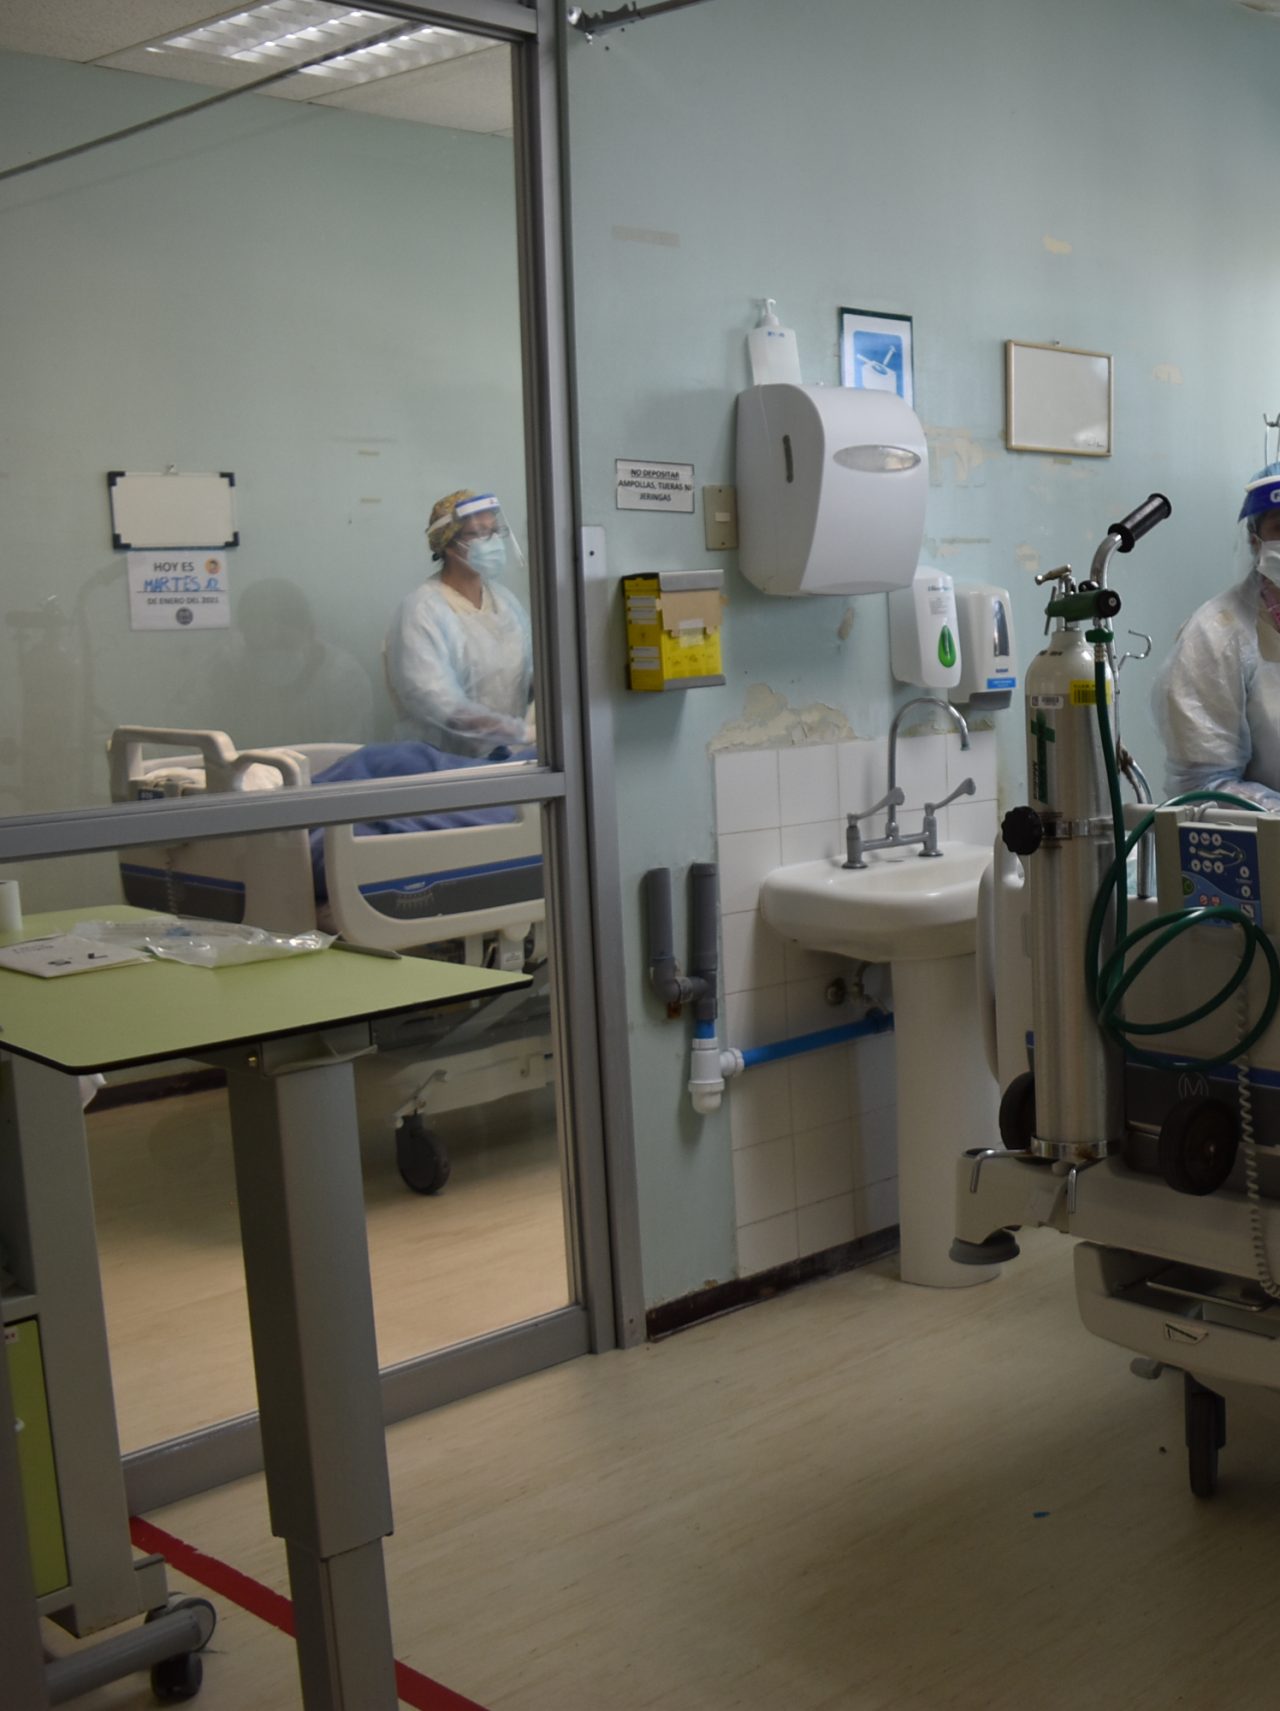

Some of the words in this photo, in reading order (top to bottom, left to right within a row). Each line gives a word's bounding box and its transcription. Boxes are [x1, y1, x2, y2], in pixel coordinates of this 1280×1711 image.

[631, 469, 641, 478] NO
[643, 470, 679, 480] DEPOSITAR
[154, 562, 178, 572] HOY
[182, 562, 195, 572] ES
[143, 576, 201, 592] MARTES
